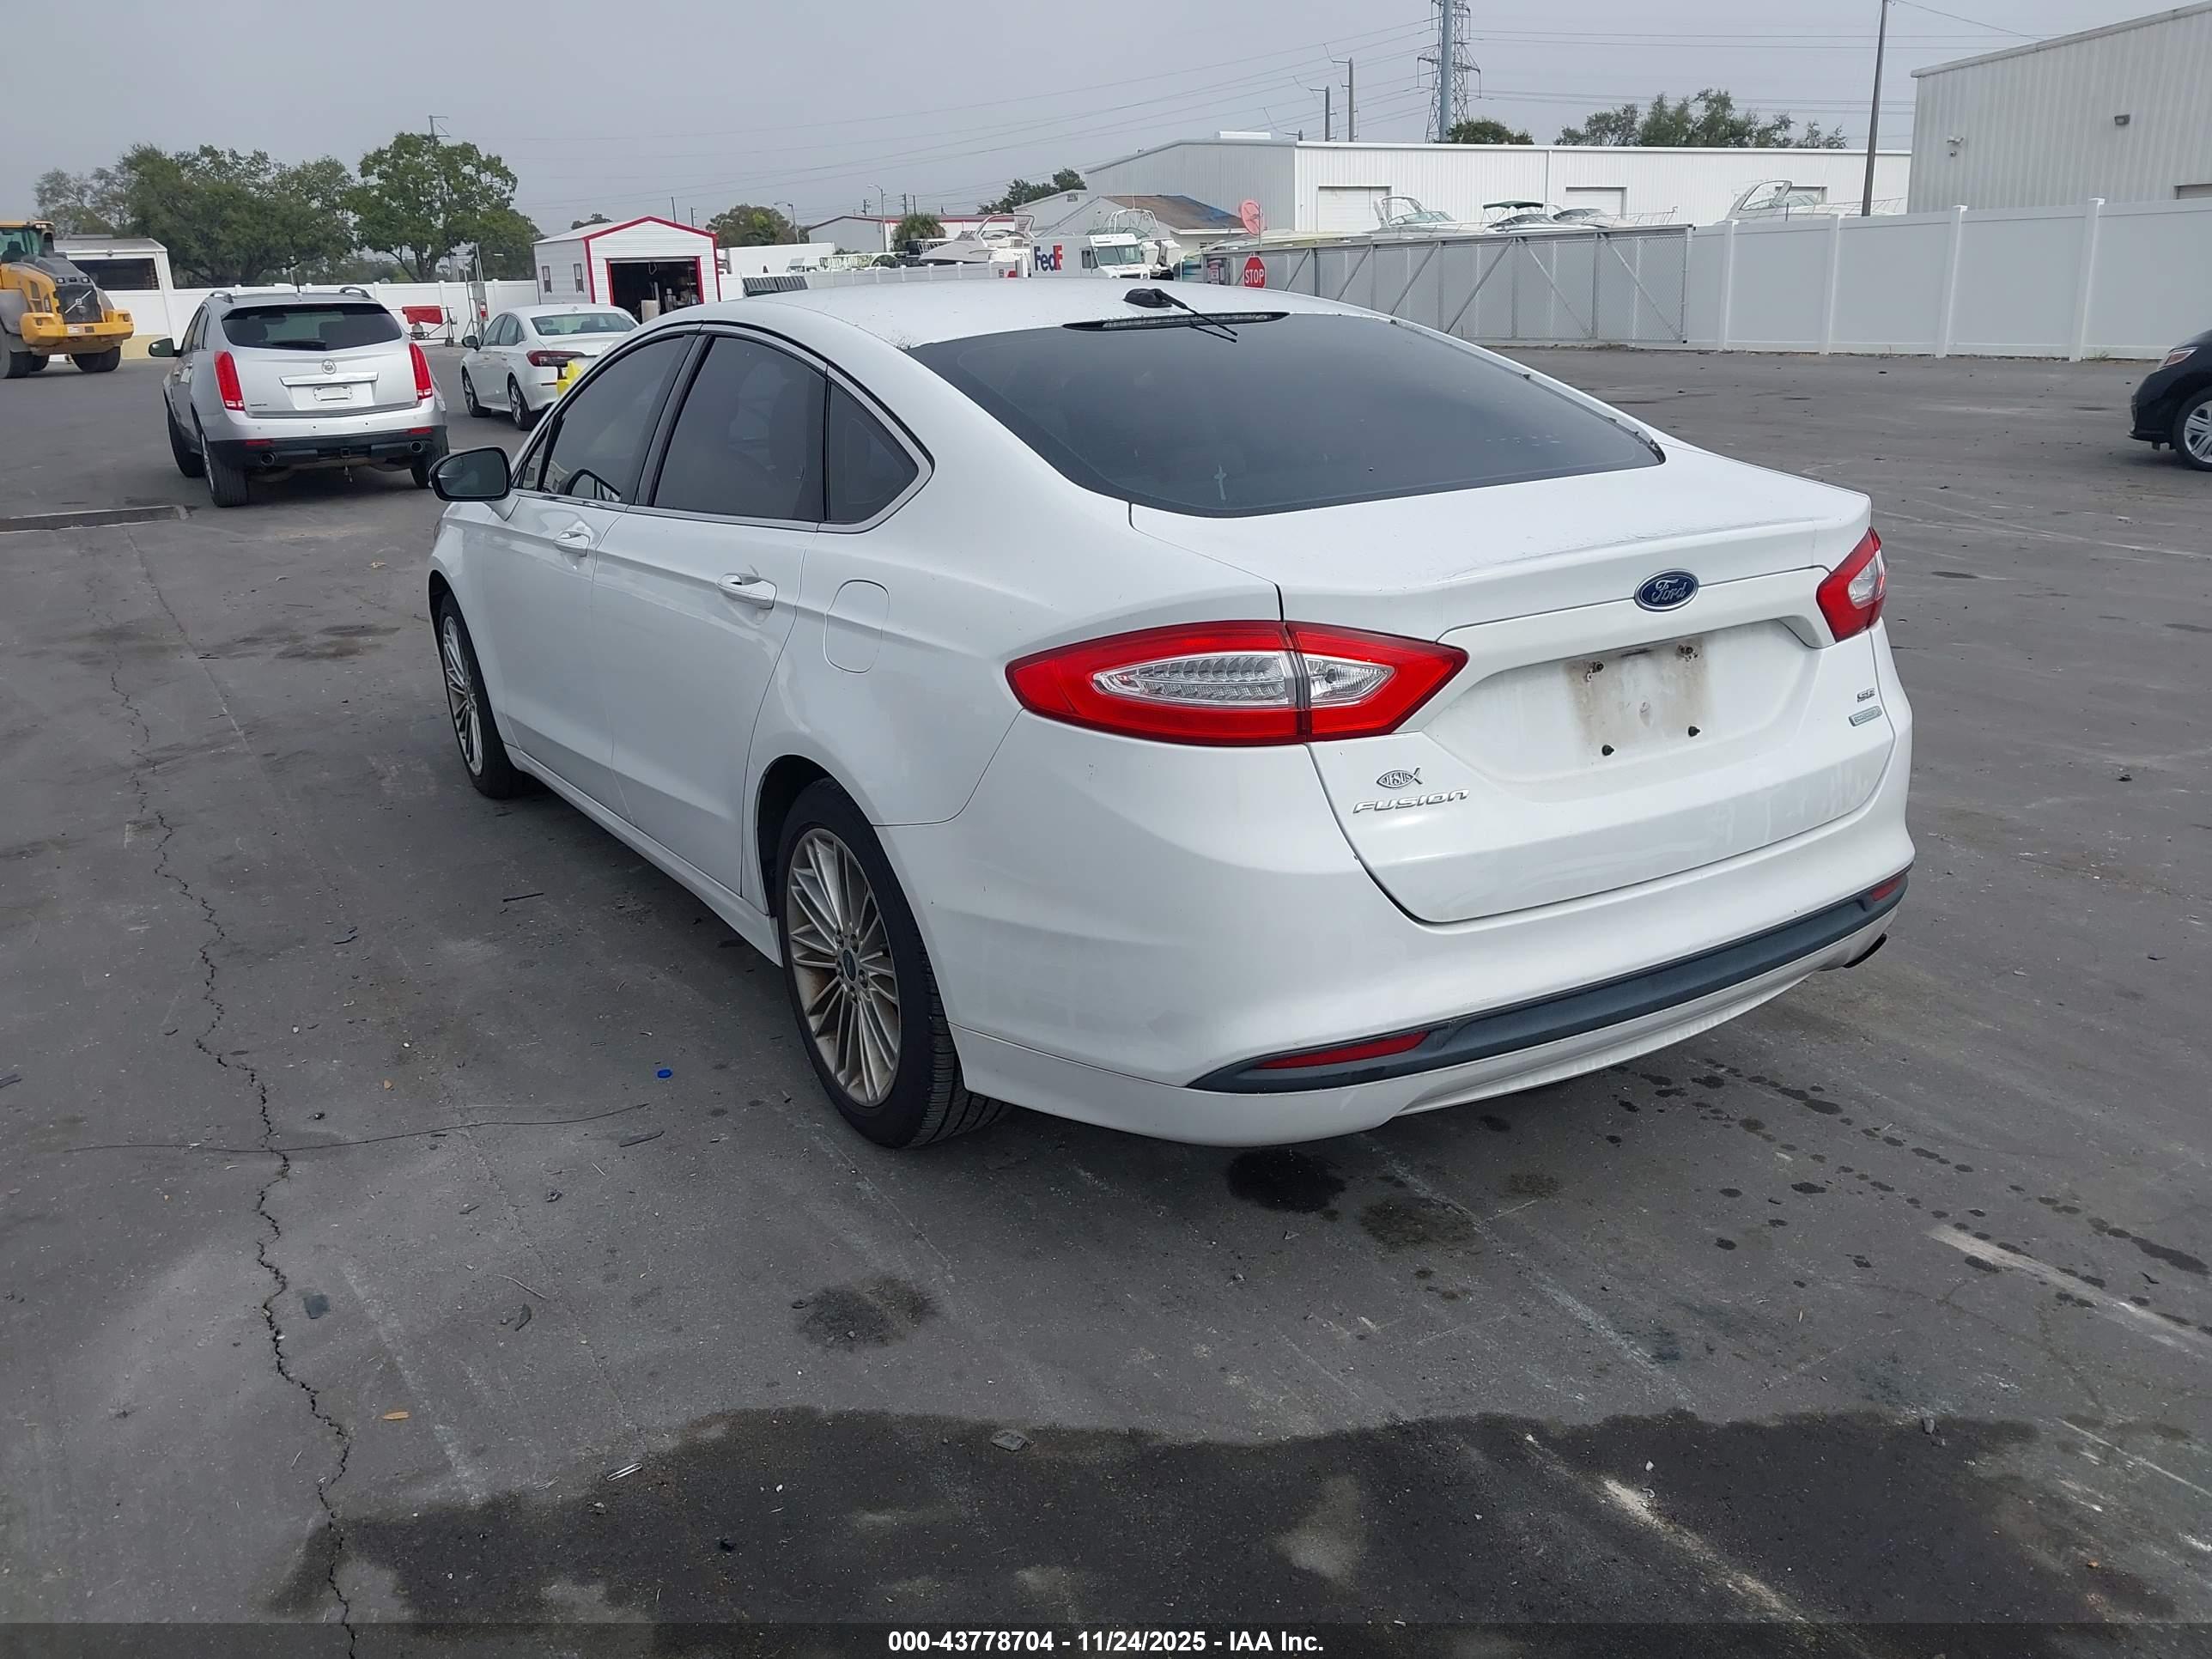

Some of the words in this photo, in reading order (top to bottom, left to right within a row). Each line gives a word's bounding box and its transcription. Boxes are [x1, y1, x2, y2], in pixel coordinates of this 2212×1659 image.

[1245, 269, 1264, 284] STOP
[1651, 578, 1687, 602] Ford
[1382, 772, 1411, 786] JESUS
